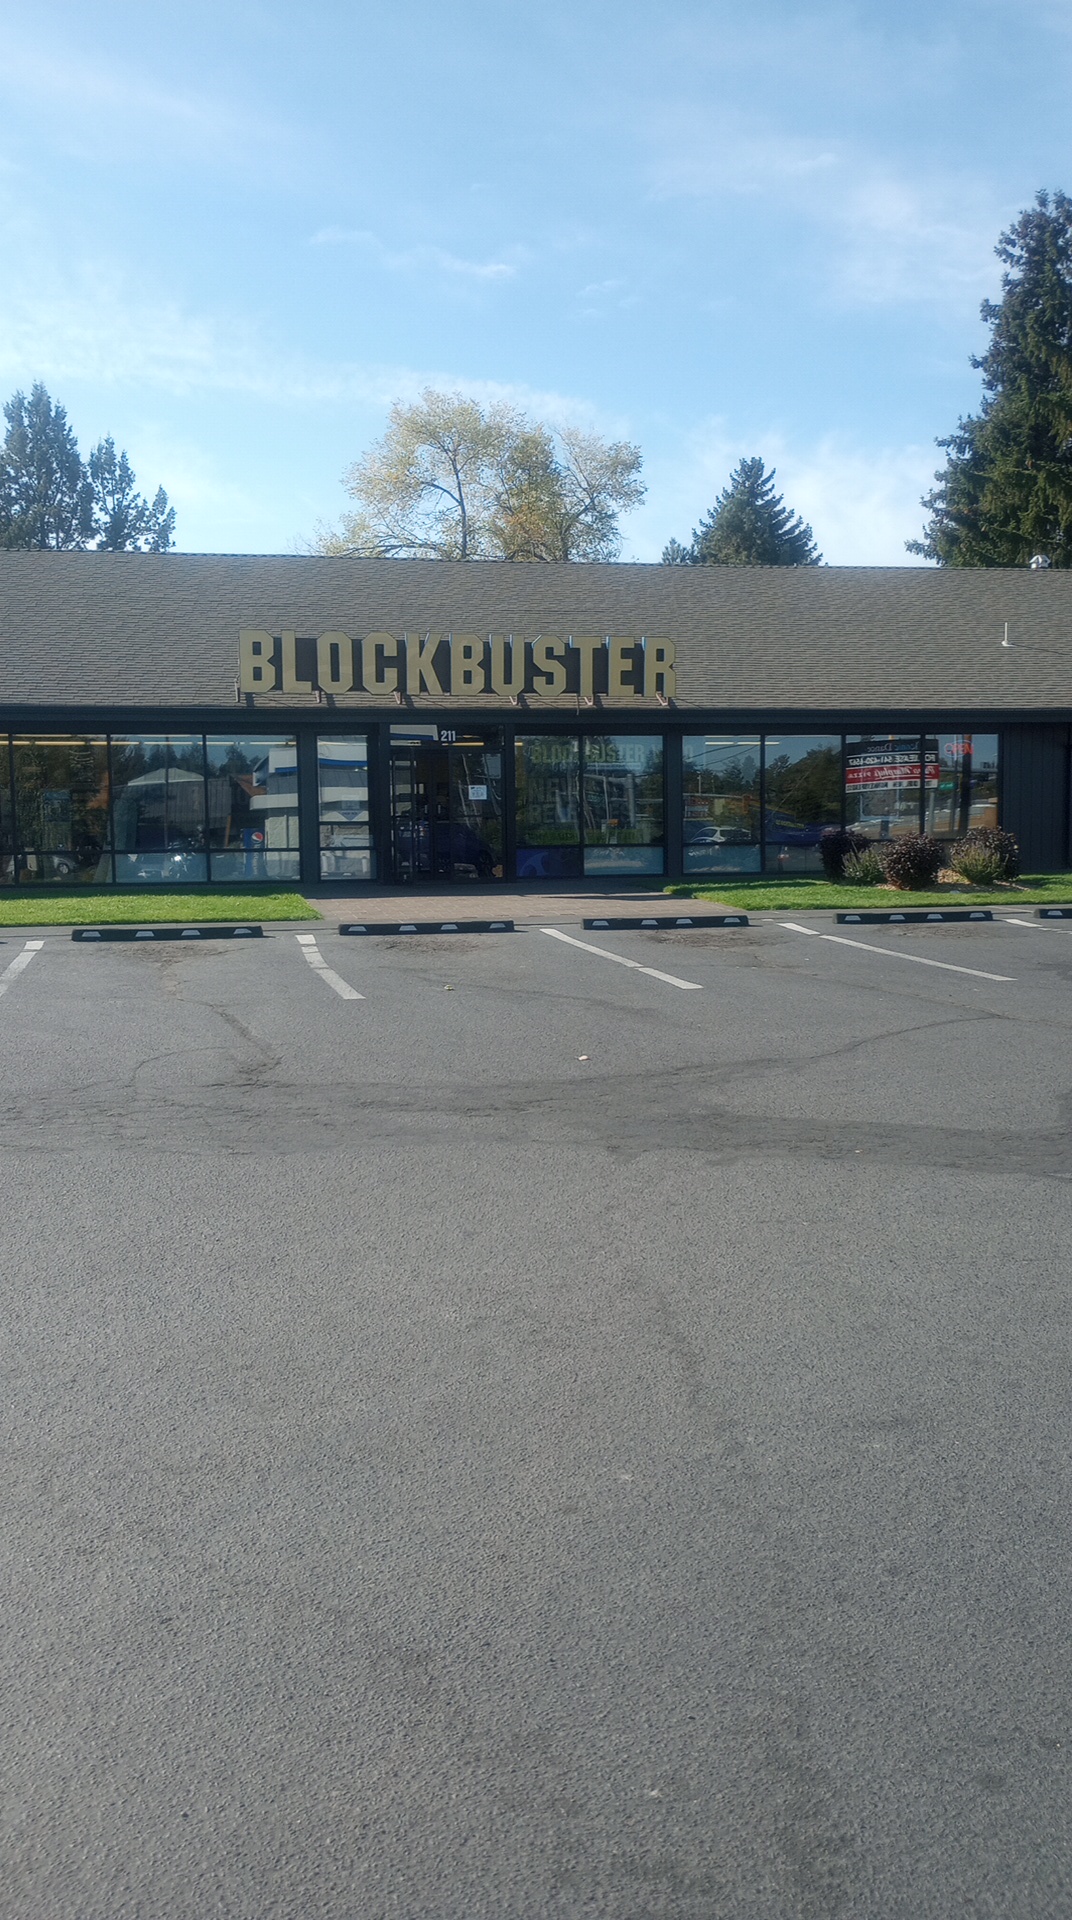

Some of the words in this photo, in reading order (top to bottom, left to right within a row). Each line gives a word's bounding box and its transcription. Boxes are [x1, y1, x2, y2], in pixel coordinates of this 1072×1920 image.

[238, 629, 676, 698] BLOCKBUSTER
[440, 730, 456, 741] 211
[531, 744, 645, 763] BLOCBUSTER
[945, 743, 974, 755] OPEN
